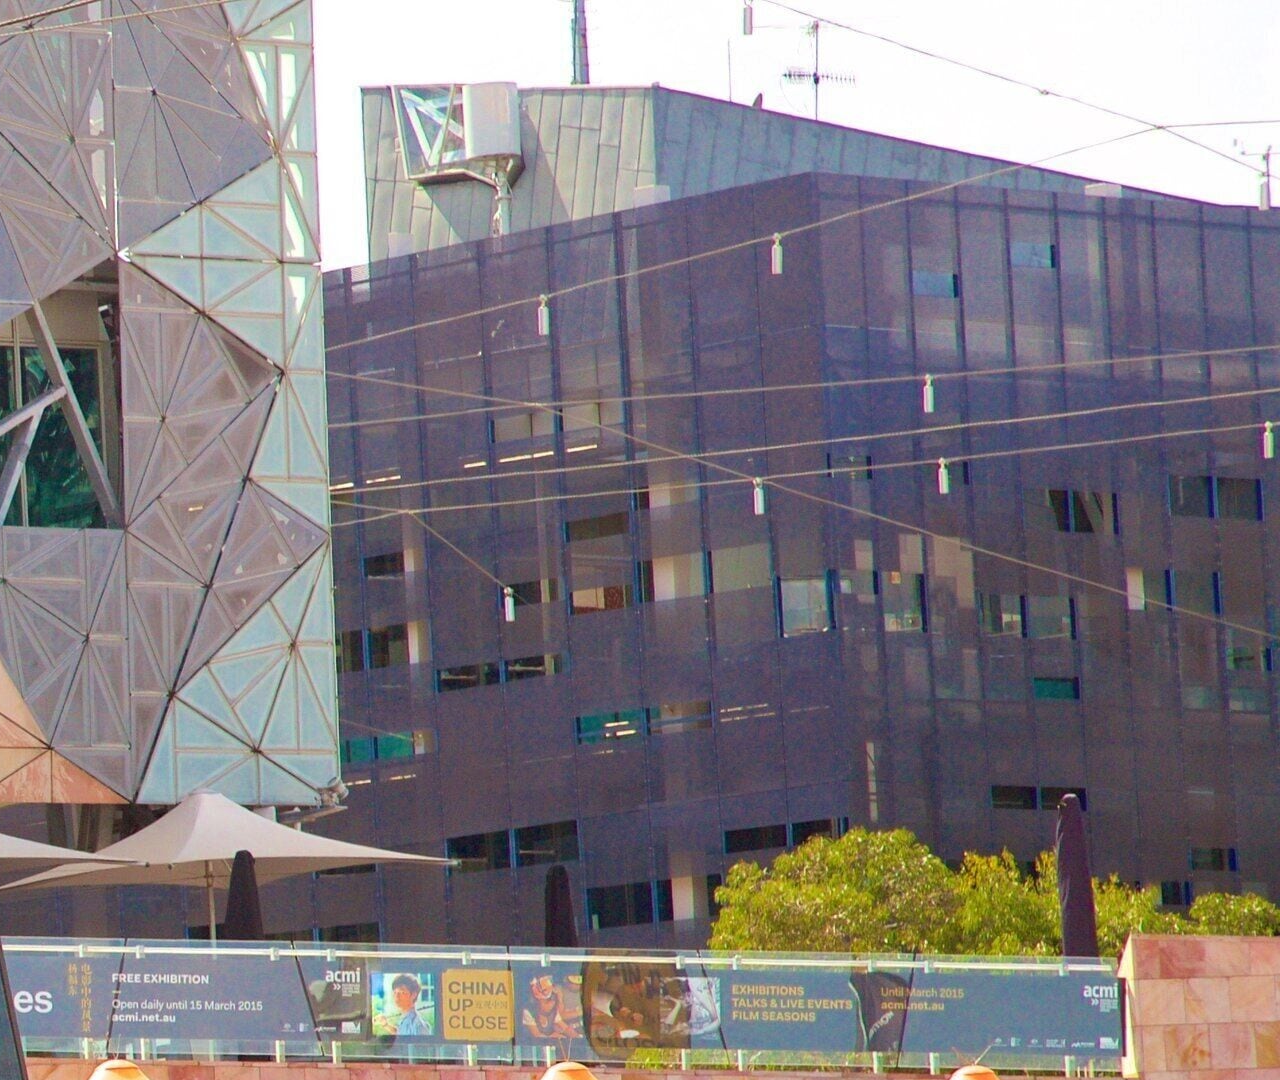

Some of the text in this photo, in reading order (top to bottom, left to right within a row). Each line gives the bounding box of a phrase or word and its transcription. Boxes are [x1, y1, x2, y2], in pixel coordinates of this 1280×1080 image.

[111, 973, 210, 985] FREE EXHIBITION
[325, 967, 361, 984] acmi
[448, 981, 508, 996] CHINA
[732, 984, 805, 997] EXHIBITIONS
[880, 987, 965, 999] Until March 2015
[1083, 982, 1119, 998] acmi
[111, 999, 263, 1012] Open daily until 15 March 2015
[448, 998, 474, 1012] UP
[732, 998, 853, 1011] TALKS & LIVE EVENTS
[880, 1001, 945, 1011] acmi.net.au
[111, 1012, 176, 1023] acmi.net.au
[448, 1015, 508, 1030] CLOSE
[732, 1011, 816, 1023] FILM SEASONS
